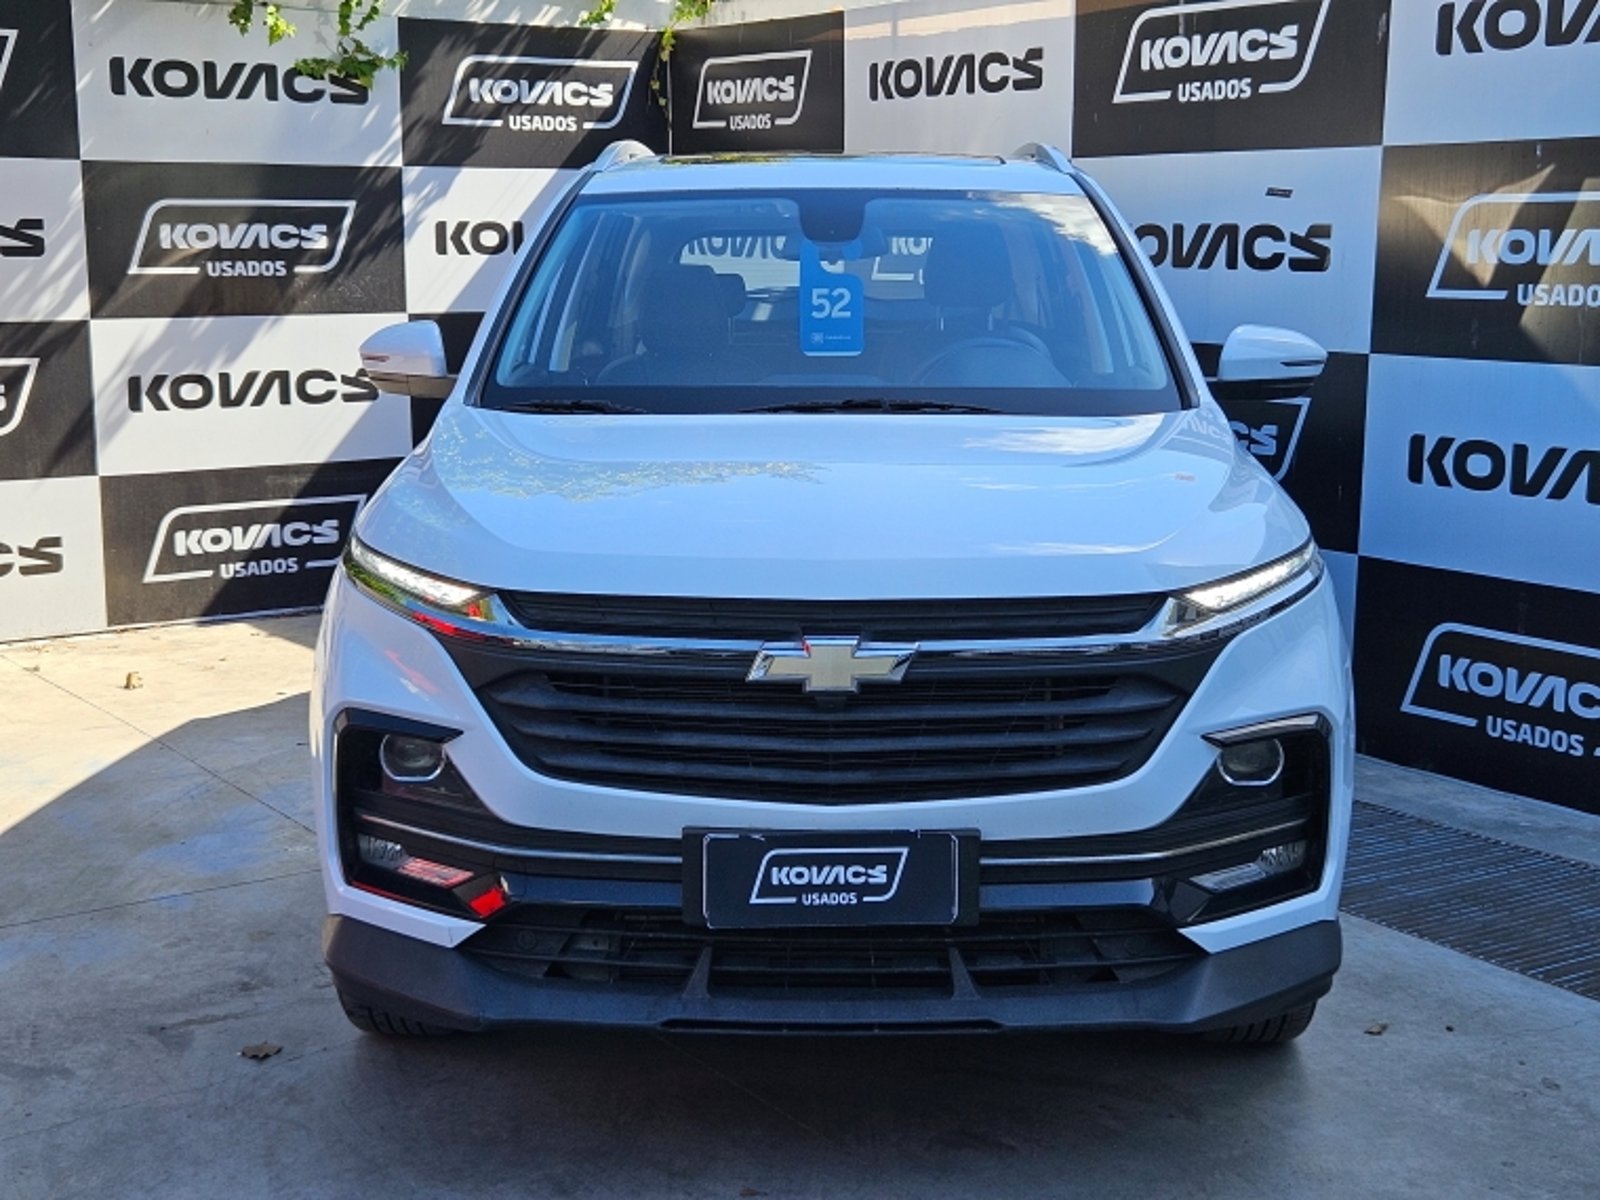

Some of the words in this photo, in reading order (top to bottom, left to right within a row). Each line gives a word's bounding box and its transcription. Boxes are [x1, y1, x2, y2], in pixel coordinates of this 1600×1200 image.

[1140, 24, 1299, 71] KOVACS
[869, 47, 1044, 101] KOVACS
[468, 77, 614, 107] KOVACS
[706, 75, 795, 105] KOVACS
[1178, 78, 1252, 103] USADOS
[508, 114, 578, 132] USADOS
[729, 113, 771, 131] USADOS
[159, 222, 328, 252] KOVACS
[206, 259, 287, 279] USADOS
[811, 287, 851, 319] 52
[127, 368, 380, 413] KOVACS
[1407, 433, 1600, 506] KOVA
[173, 519, 340, 556] KOVACS
[220, 557, 299, 579] USADOS
[1437, 653, 1600, 719] KOVAC
[1486, 715, 1584, 757] USADOS
[771, 865, 888, 886] KOVACS
[801, 892, 858, 906] USADOS
